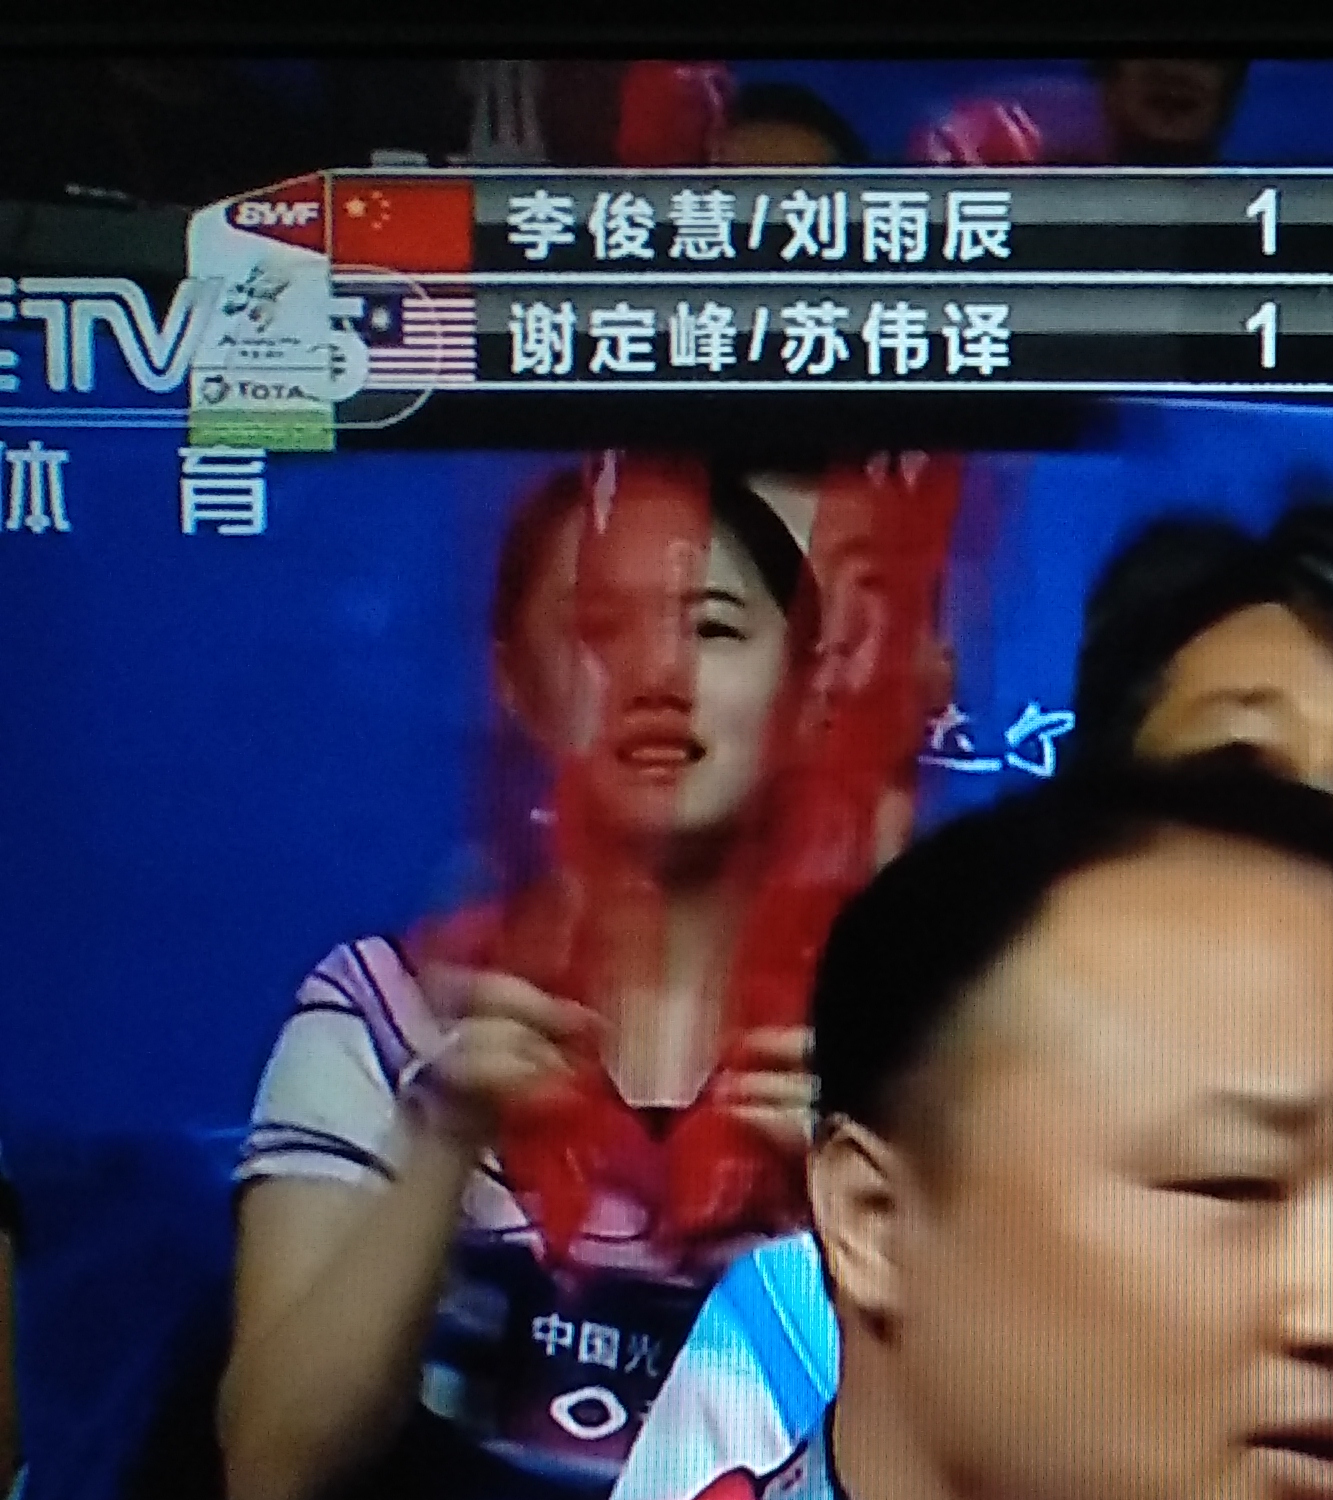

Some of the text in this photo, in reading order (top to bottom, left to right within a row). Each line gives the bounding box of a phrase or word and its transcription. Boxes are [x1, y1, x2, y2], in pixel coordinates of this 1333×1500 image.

[236, 201, 321, 227] BWF
[505, 189, 1013, 264] 李俊慧/刘雨辰
[1246, 187, 1278, 257] 1
[0, 276, 208, 393] TV
[508, 299, 1013, 376] 谢定峰/苏伟译
[1246, 302, 1278, 370] 1
